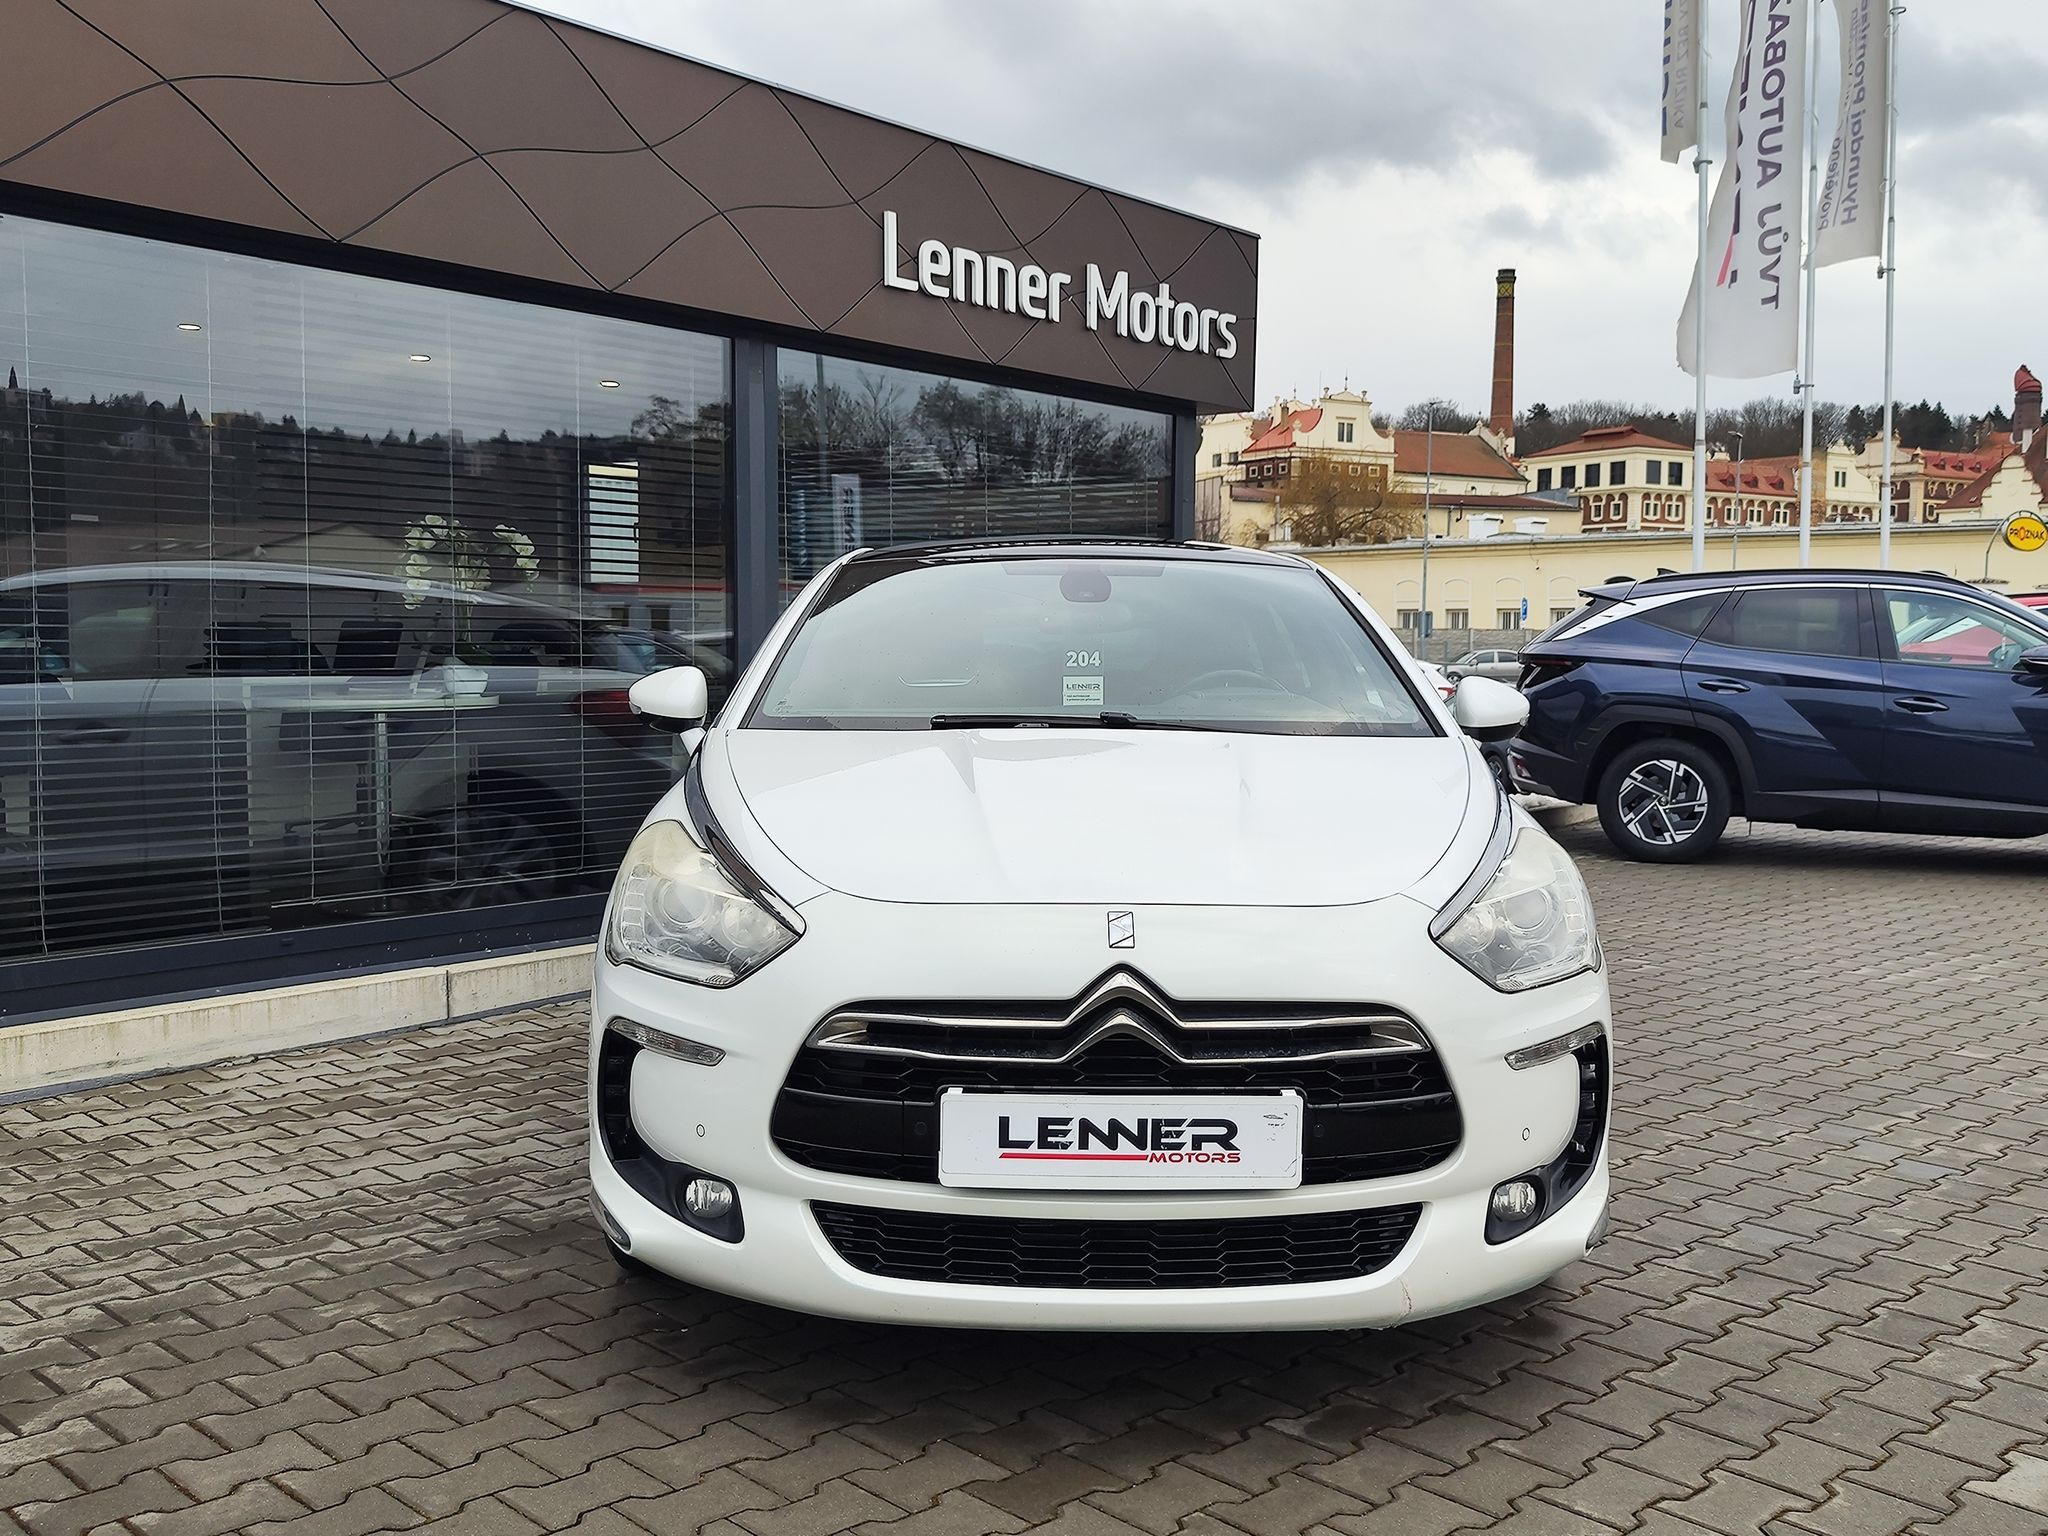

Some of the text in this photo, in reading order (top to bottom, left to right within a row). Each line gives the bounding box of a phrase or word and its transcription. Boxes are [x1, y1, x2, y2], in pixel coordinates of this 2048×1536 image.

[882, 210, 1237, 359] Lenner Motors
[2009, 526, 2045, 541] PROZNAK
[1065, 651, 1102, 667] 204
[998, 1115, 1241, 1151] LENNER
[1149, 1152, 1241, 1164] MOTORS
